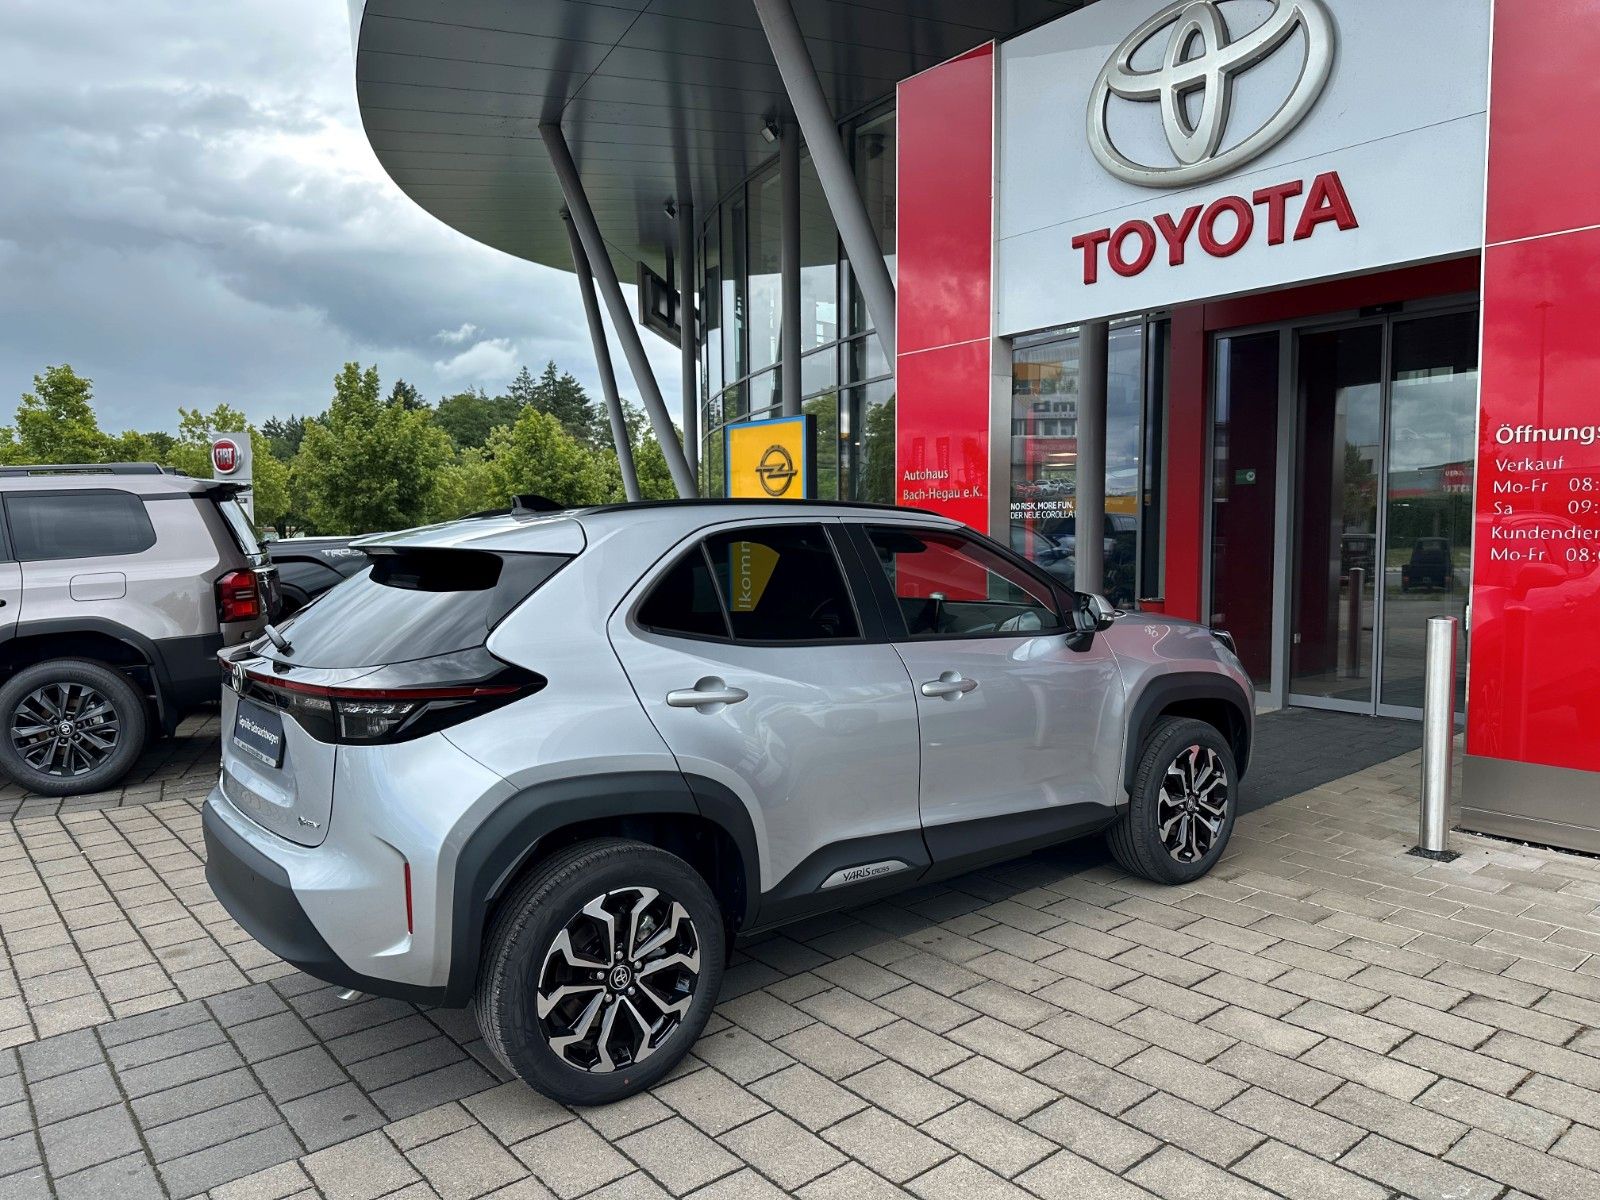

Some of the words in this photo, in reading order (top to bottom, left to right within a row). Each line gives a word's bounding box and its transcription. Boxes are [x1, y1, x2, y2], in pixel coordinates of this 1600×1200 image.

[1072, 171, 1359, 285] TOYOTA
[215, 448, 234, 465] FIAT
[1495, 456, 1564, 472] Verkauf
[903, 468, 949, 481] Autohaus
[1493, 479, 1549, 493] Mo-Fr
[1569, 477, 1600, 492] 08:
[903, 488, 960, 502] Bach-Hegau
[963, 485, 983, 498] e.K.
[1010, 502, 1020, 511] NO
[1020, 502, 1037, 511] RISK,
[1037, 501, 1057, 510] MORE
[1057, 500, 1074, 509] FUN.
[1493, 501, 1513, 515] Sa
[1567, 499, 1600, 514] 09:
[1010, 511, 1023, 520] DER
[1023, 510, 1041, 519] NEUE
[1041, 510, 1073, 519] COROLLA
[1490, 547, 1546, 561] Mo-Fr
[1566, 547, 1600, 562] 08:
[843, 867, 870, 881] YARIS
[871, 866, 890, 875] CROSS
